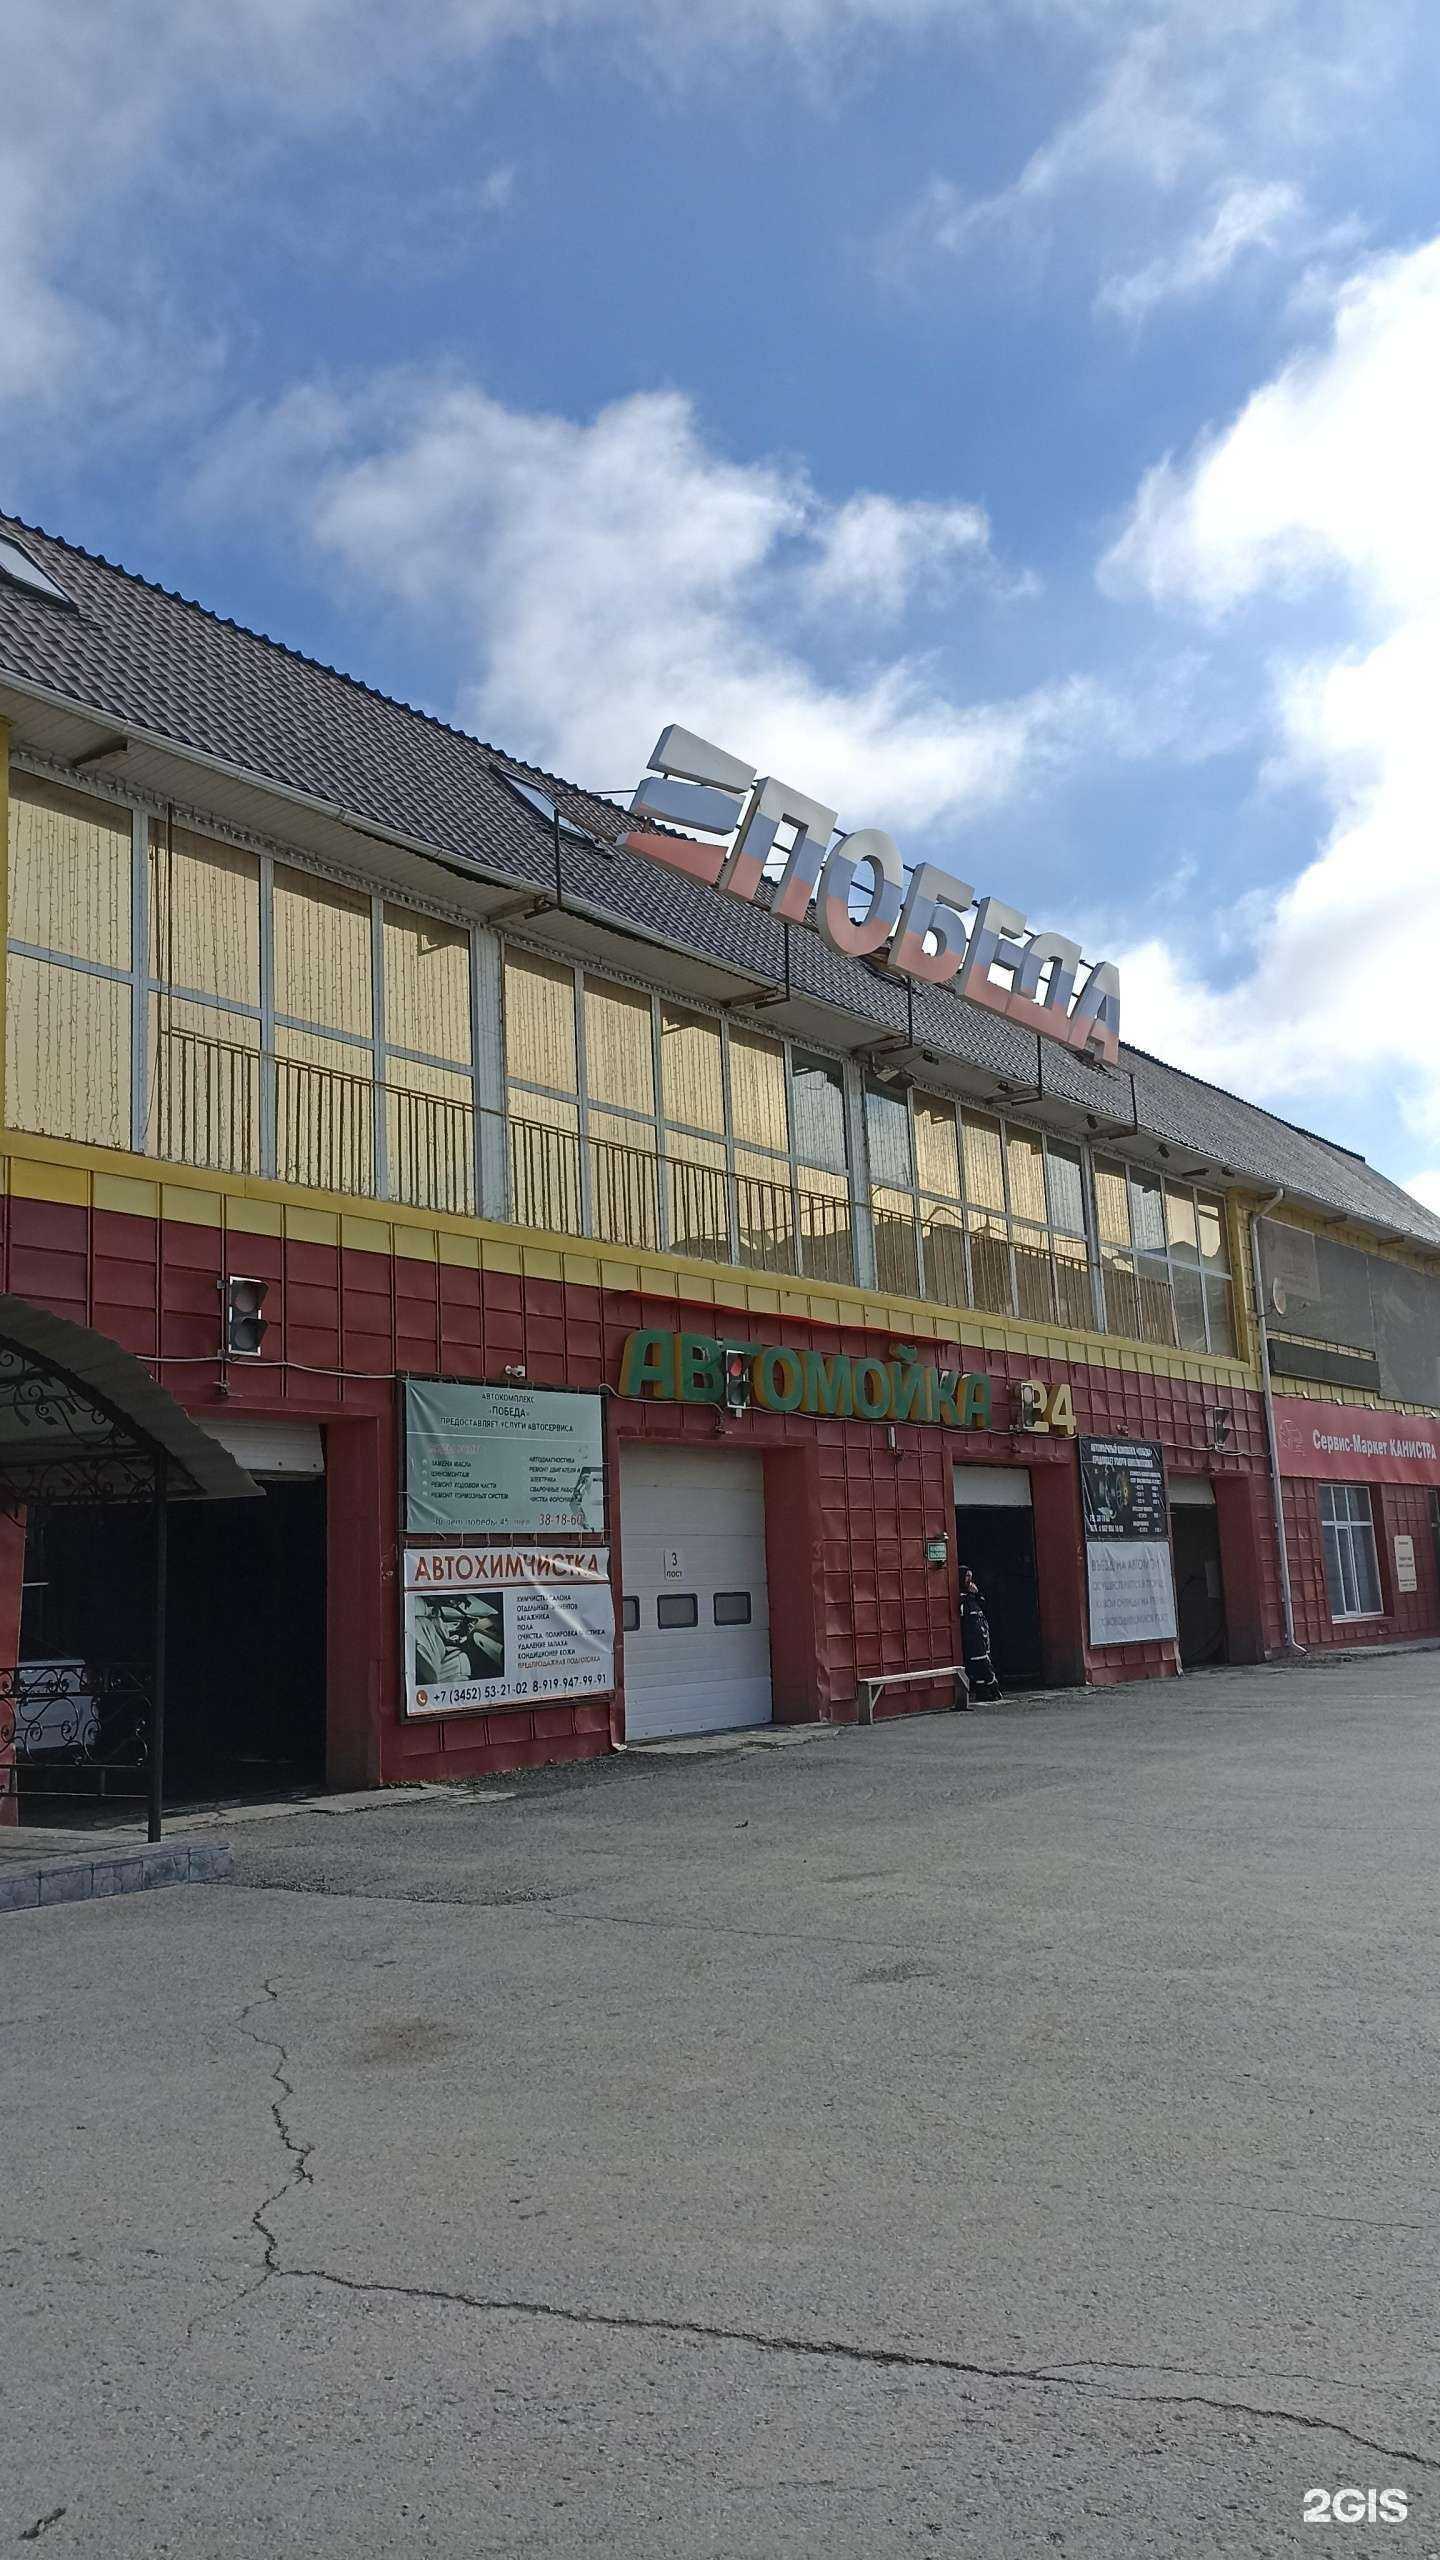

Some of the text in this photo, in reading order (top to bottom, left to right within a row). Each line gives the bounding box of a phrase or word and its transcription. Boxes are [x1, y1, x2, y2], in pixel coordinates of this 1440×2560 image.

[718, 775, 1121, 1066] ПОБЕДА
[619, 1328, 992, 1428] АВТОМОЙКА
[528, 1424, 574, 1433] АВТОСЕРВИСА
[1312, 1427, 1438, 1460] Сервис-Маркет КАНИСТРА
[415, 1553, 600, 1581] АВТОХИМЧИСТКА
[672, 1552, 677, 1566] 3
[434, 1673, 607, 1705] +7 (3452) 53-21-02 8-919-947-99-91
